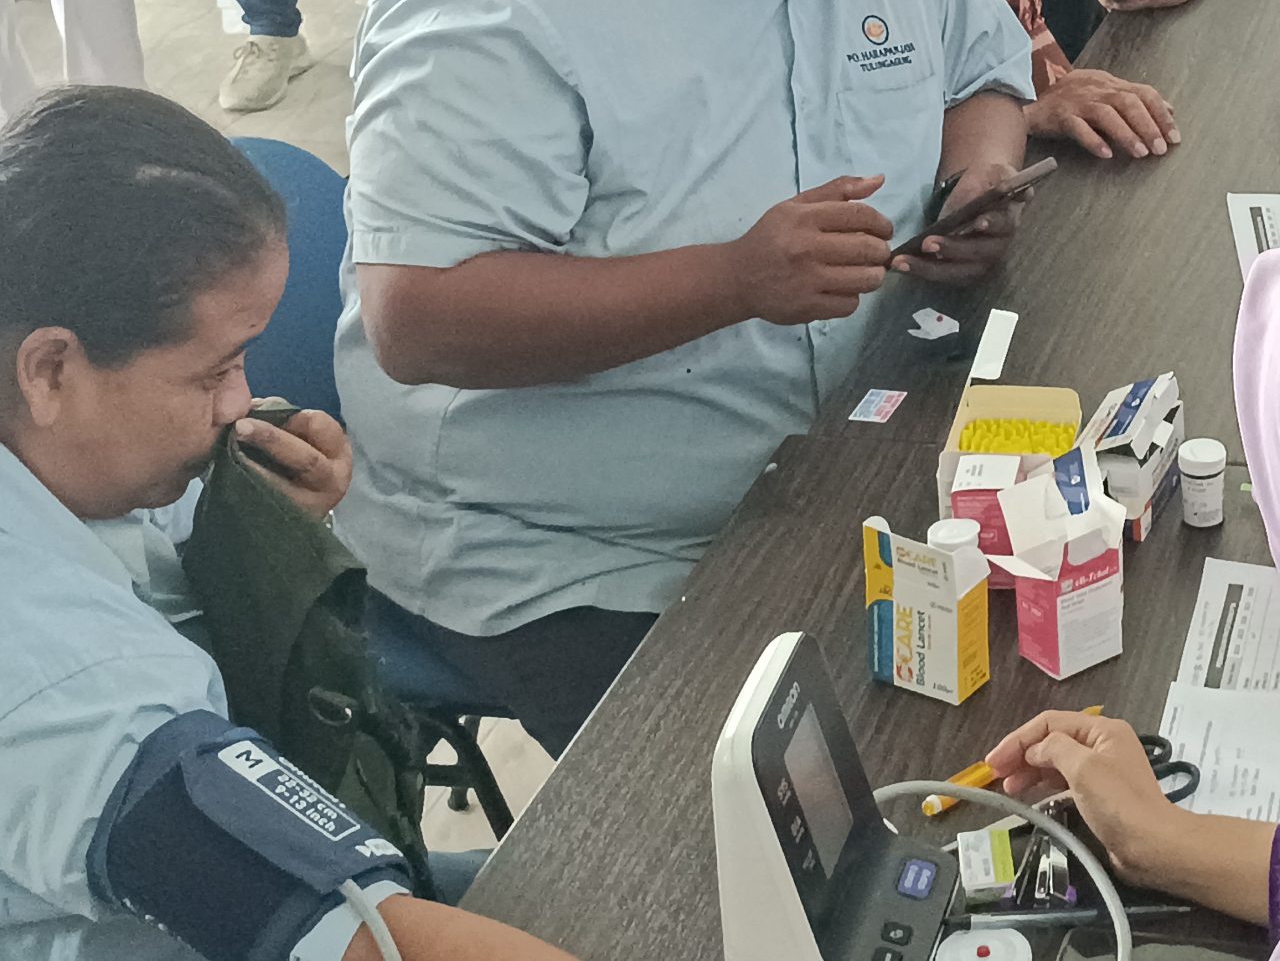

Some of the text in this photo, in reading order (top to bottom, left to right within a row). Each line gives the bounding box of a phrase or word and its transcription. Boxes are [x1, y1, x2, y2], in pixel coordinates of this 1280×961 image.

[916, 610, 926, 686] Blood Lancet
[235, 750, 264, 769] M
[305, 808, 336, 832] inch
[317, 802, 338, 820] cm
